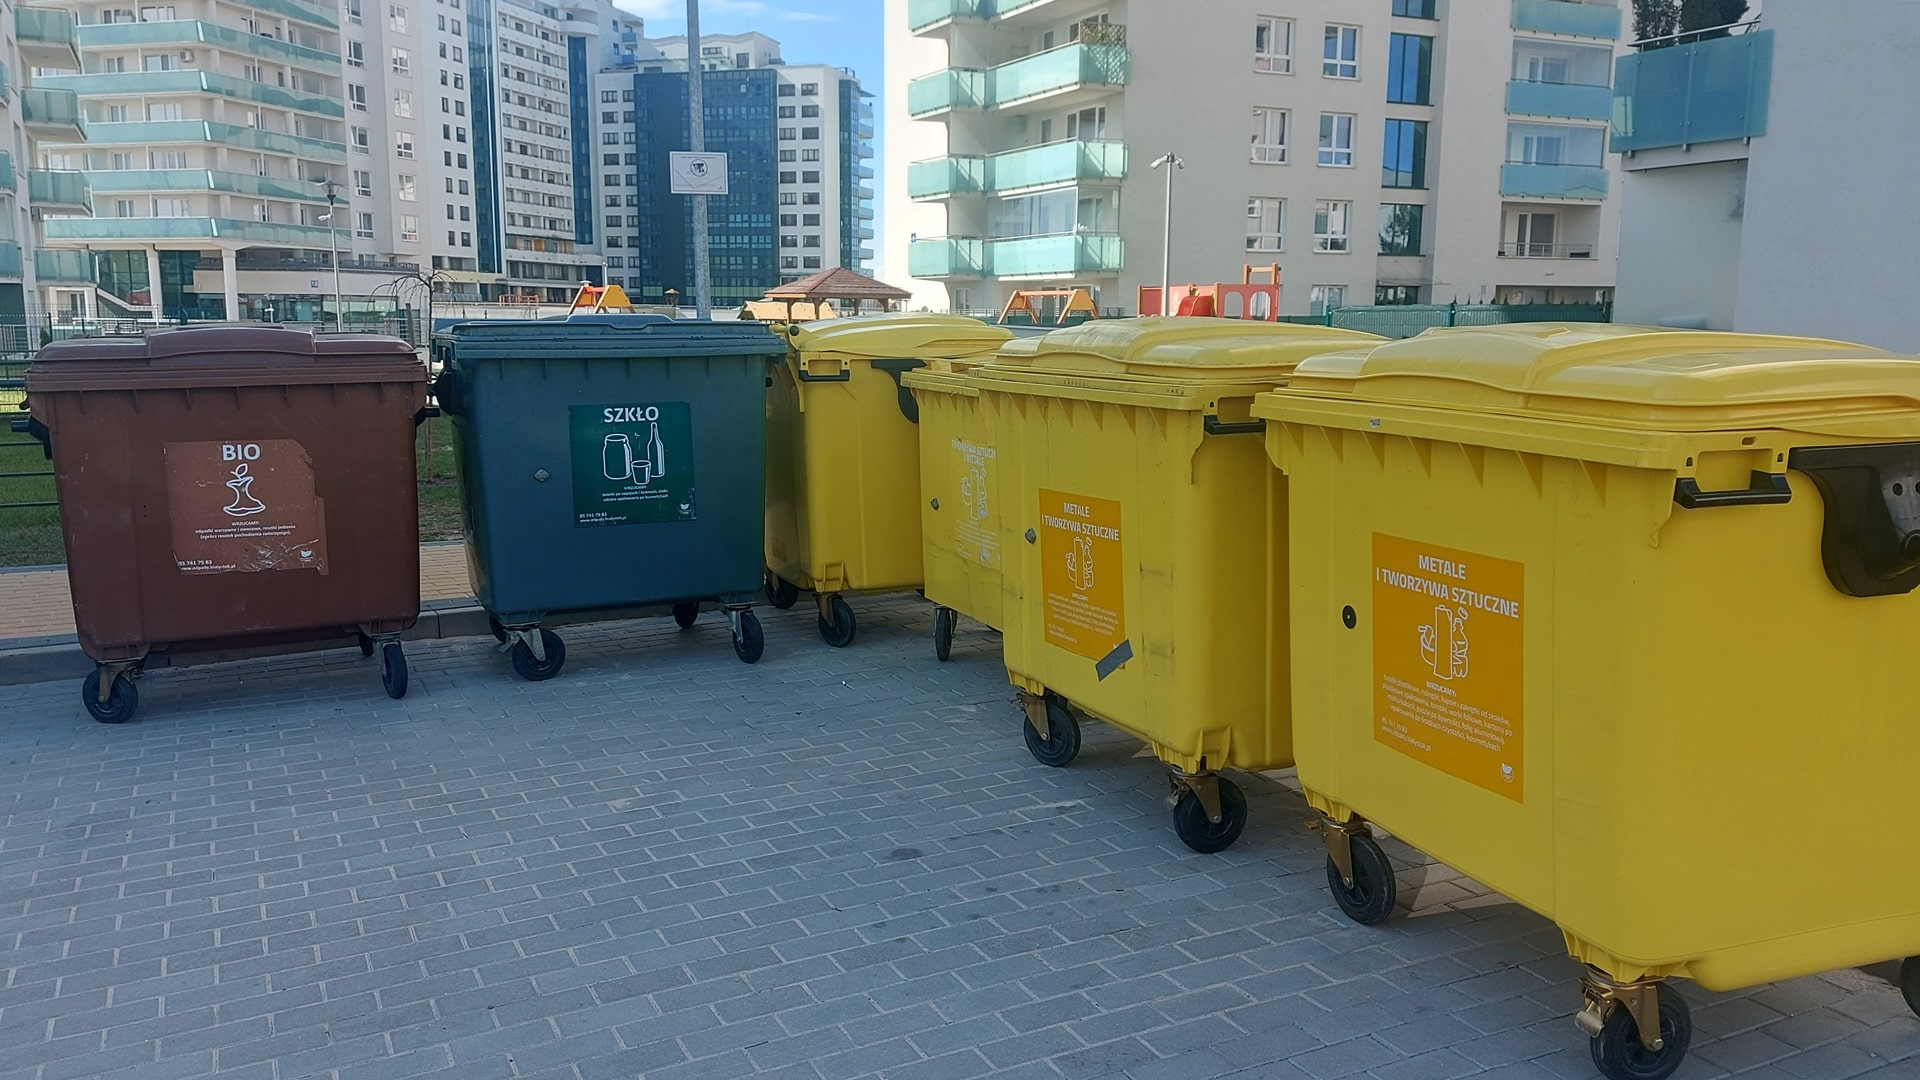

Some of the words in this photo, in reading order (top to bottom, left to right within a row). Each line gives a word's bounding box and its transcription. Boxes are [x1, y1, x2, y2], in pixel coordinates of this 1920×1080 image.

[604, 406, 659, 422] SZKŁO
[222, 444, 261, 461] BIO
[1064, 502, 1090, 517] METALE
[1041, 514, 1044, 524] I
[1044, 515, 1081, 533] TWORZYWA
[1082, 523, 1119, 541] SZTUCZNE
[1418, 555, 1466, 580] METALE
[1376, 567, 1379, 581] I
[1382, 569, 1449, 600] TWORZYWA
[1452, 587, 1519, 618] SZTUCZNE
[1484, 720, 1504, 735] kartony
[1466, 734, 1501, 752] kosmetykach
